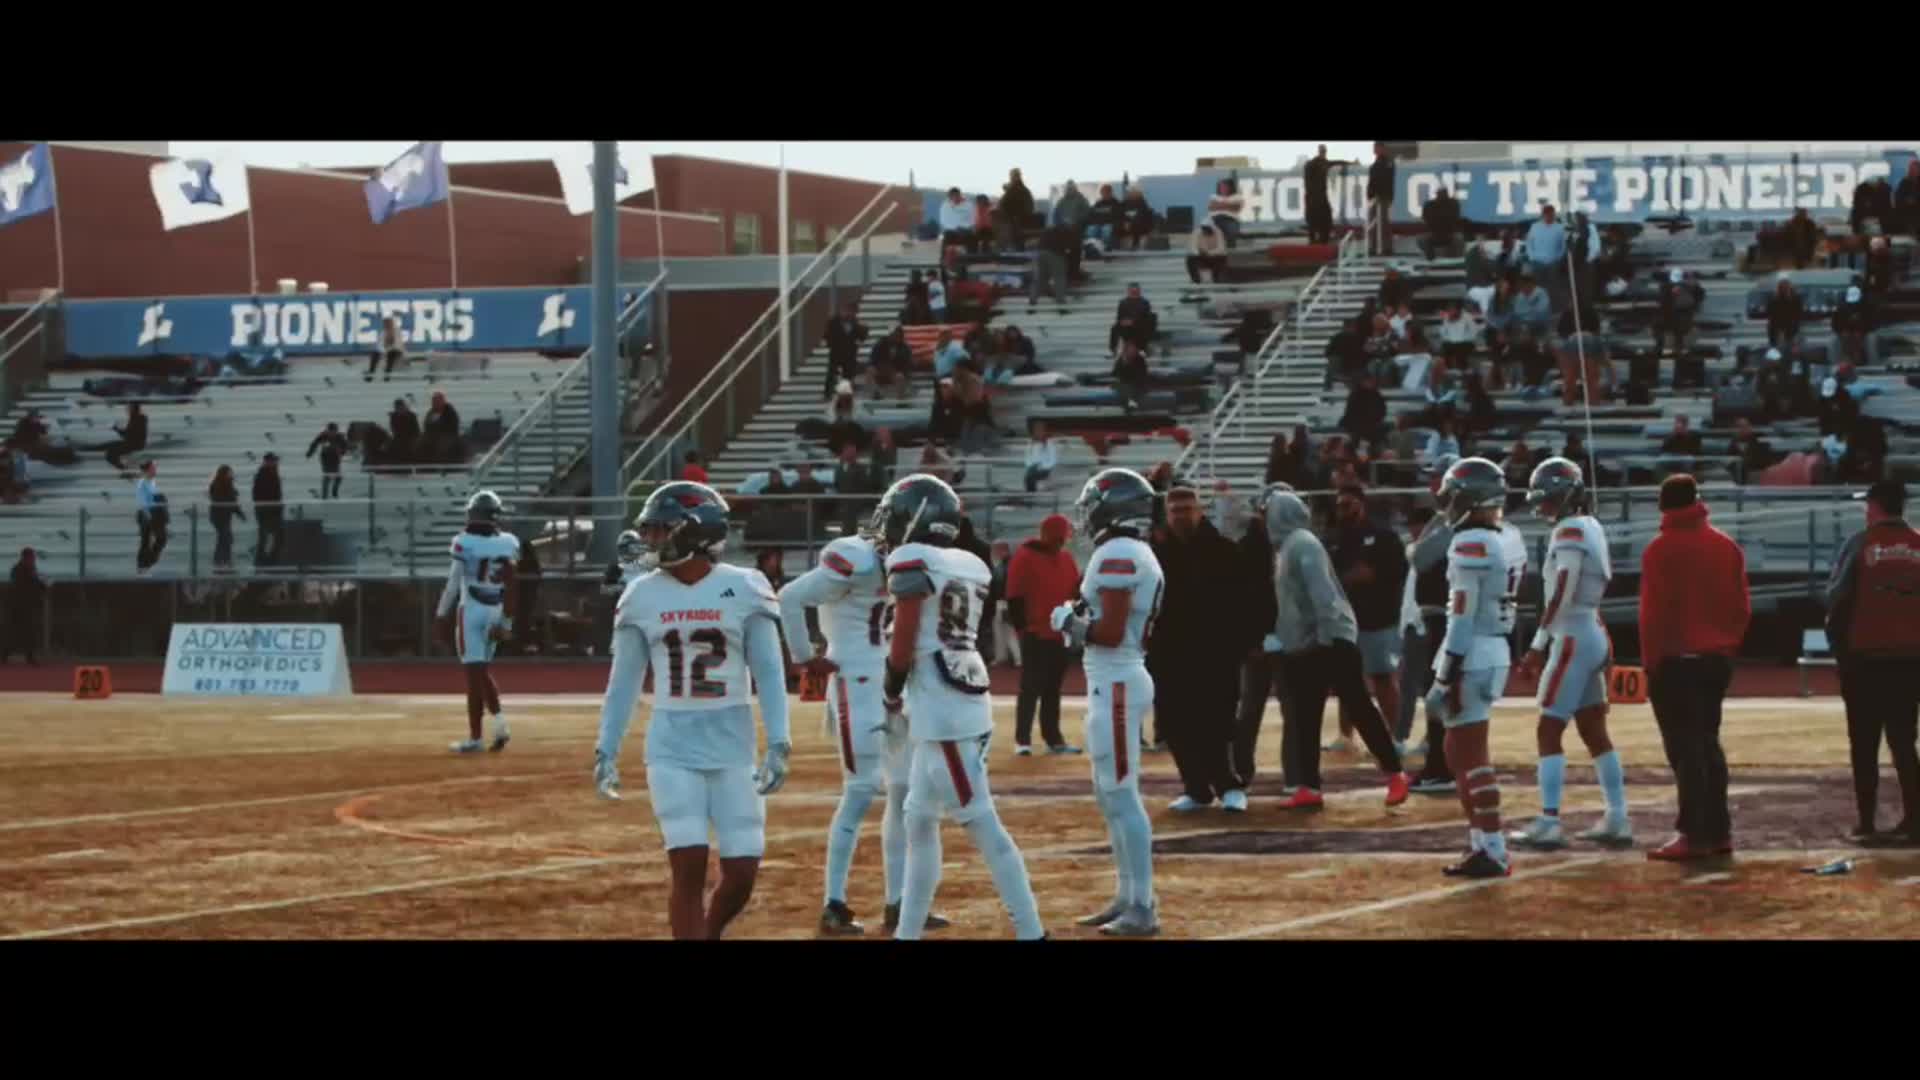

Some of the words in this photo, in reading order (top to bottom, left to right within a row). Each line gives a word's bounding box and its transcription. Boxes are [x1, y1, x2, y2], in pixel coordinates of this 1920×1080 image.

[1406, 171, 1473, 218] OF
[1487, 168, 1598, 216] THE
[230, 298, 475, 347] PIONEERS
[660, 608, 724, 624] SKYRIDGE
[181, 627, 327, 650] ADVANCED
[177, 655, 322, 673] ORTHOPEDICS
[662, 626, 728, 698] 12
[1613, 670, 1639, 697] 40
